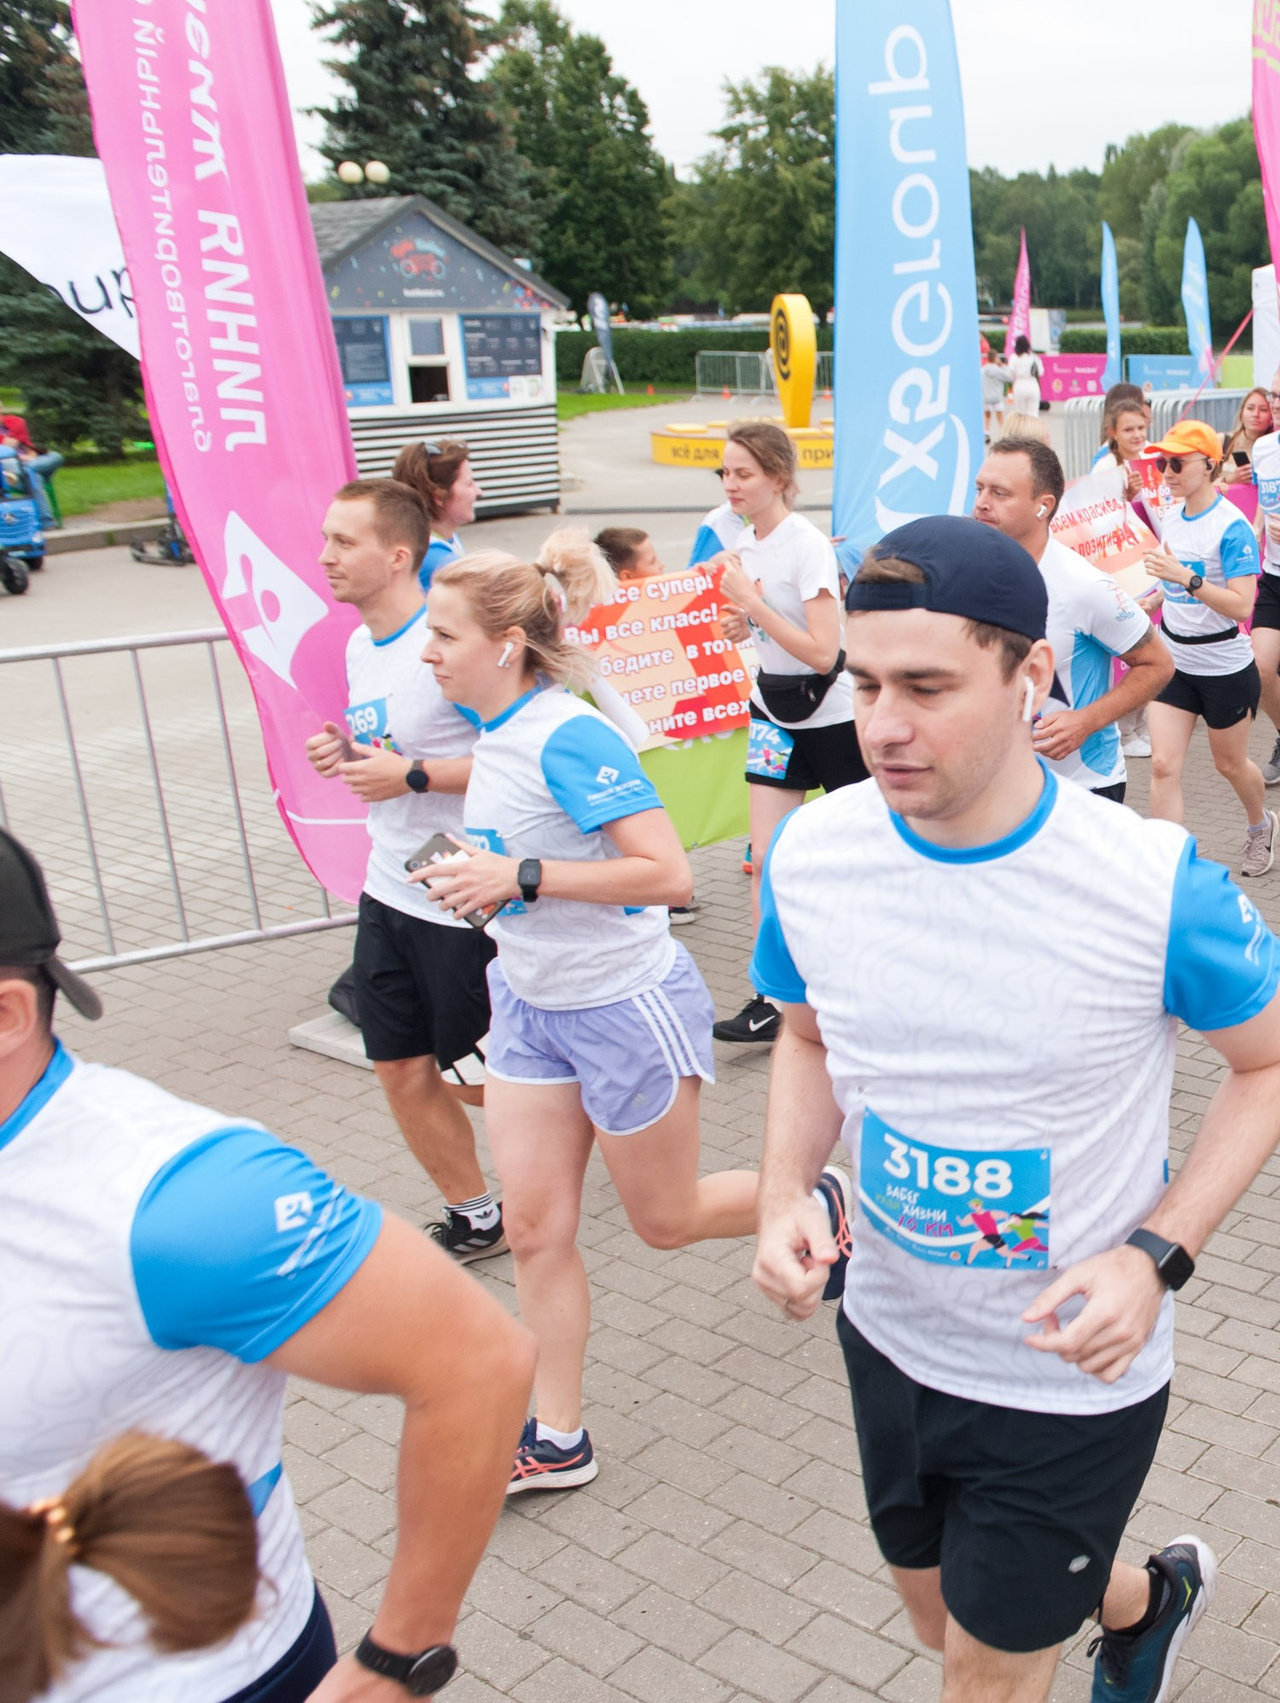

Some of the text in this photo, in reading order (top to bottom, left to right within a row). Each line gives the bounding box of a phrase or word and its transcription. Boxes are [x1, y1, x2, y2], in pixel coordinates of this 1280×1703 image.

[646, 573, 714, 601] супер!
[564, 602, 718, 646] Вы все класс!
[686, 644, 699, 660] в
[671, 667, 745, 697] первое
[645, 709, 697, 735] ните
[883, 1133, 1013, 1199] 3188
[898, 1215, 917, 1233] 10
